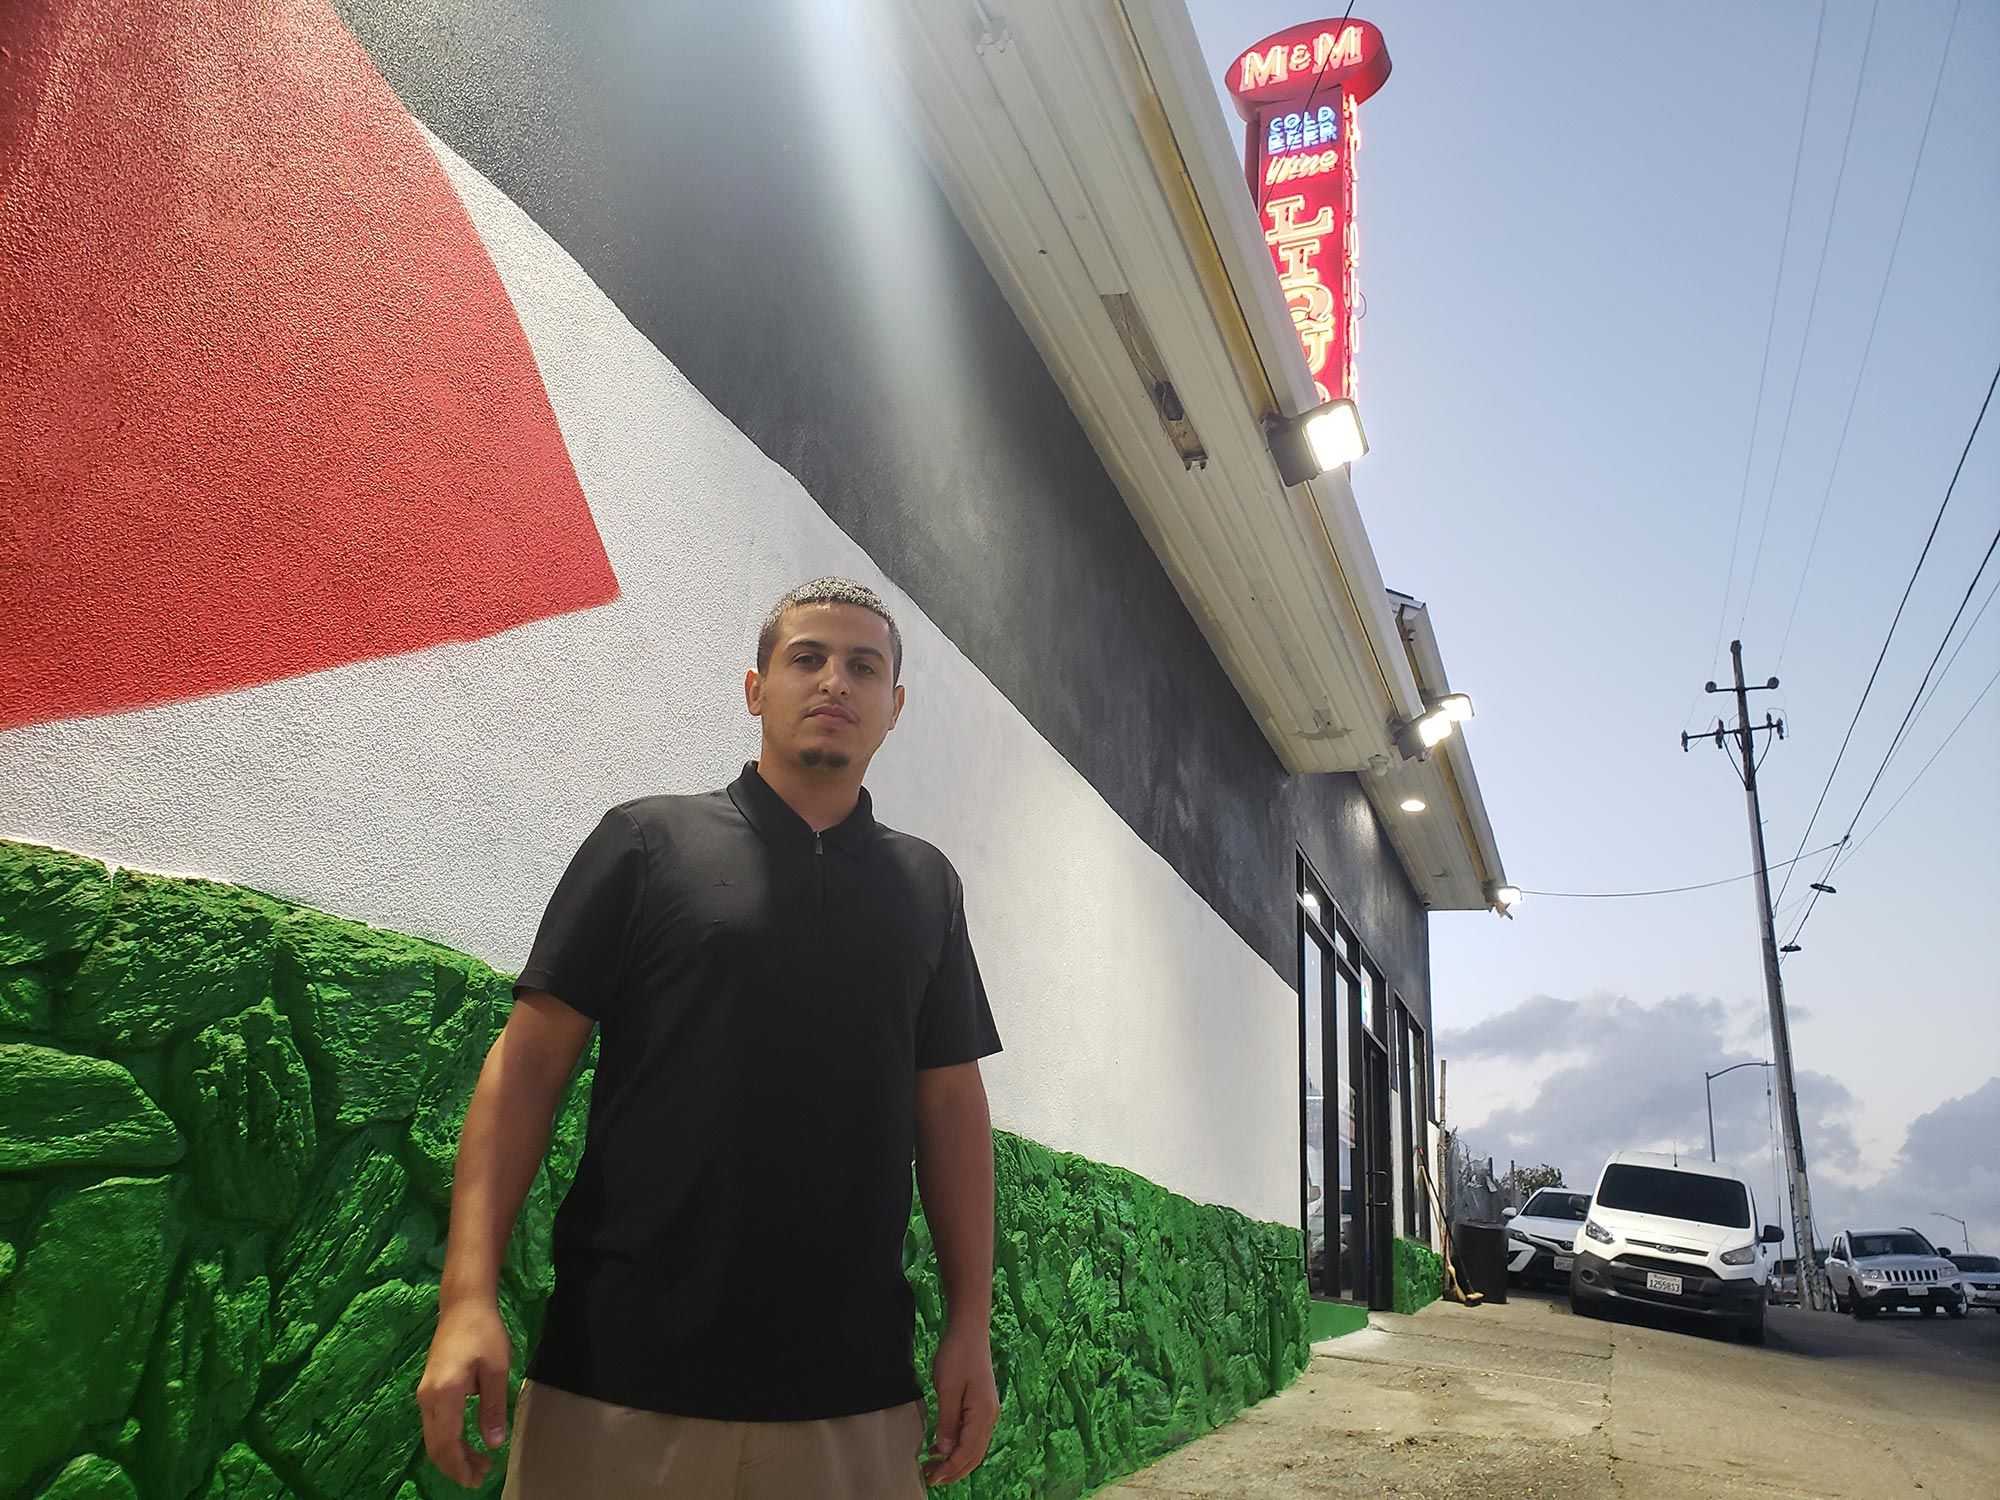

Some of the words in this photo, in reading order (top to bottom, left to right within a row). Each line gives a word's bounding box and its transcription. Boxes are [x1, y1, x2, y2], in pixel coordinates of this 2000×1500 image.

[1239, 26, 1363, 92] M&M
[1270, 106, 1337, 134] COLD
[1268, 121, 1337, 155] BEER
[1265, 150, 1338, 186] Wine
